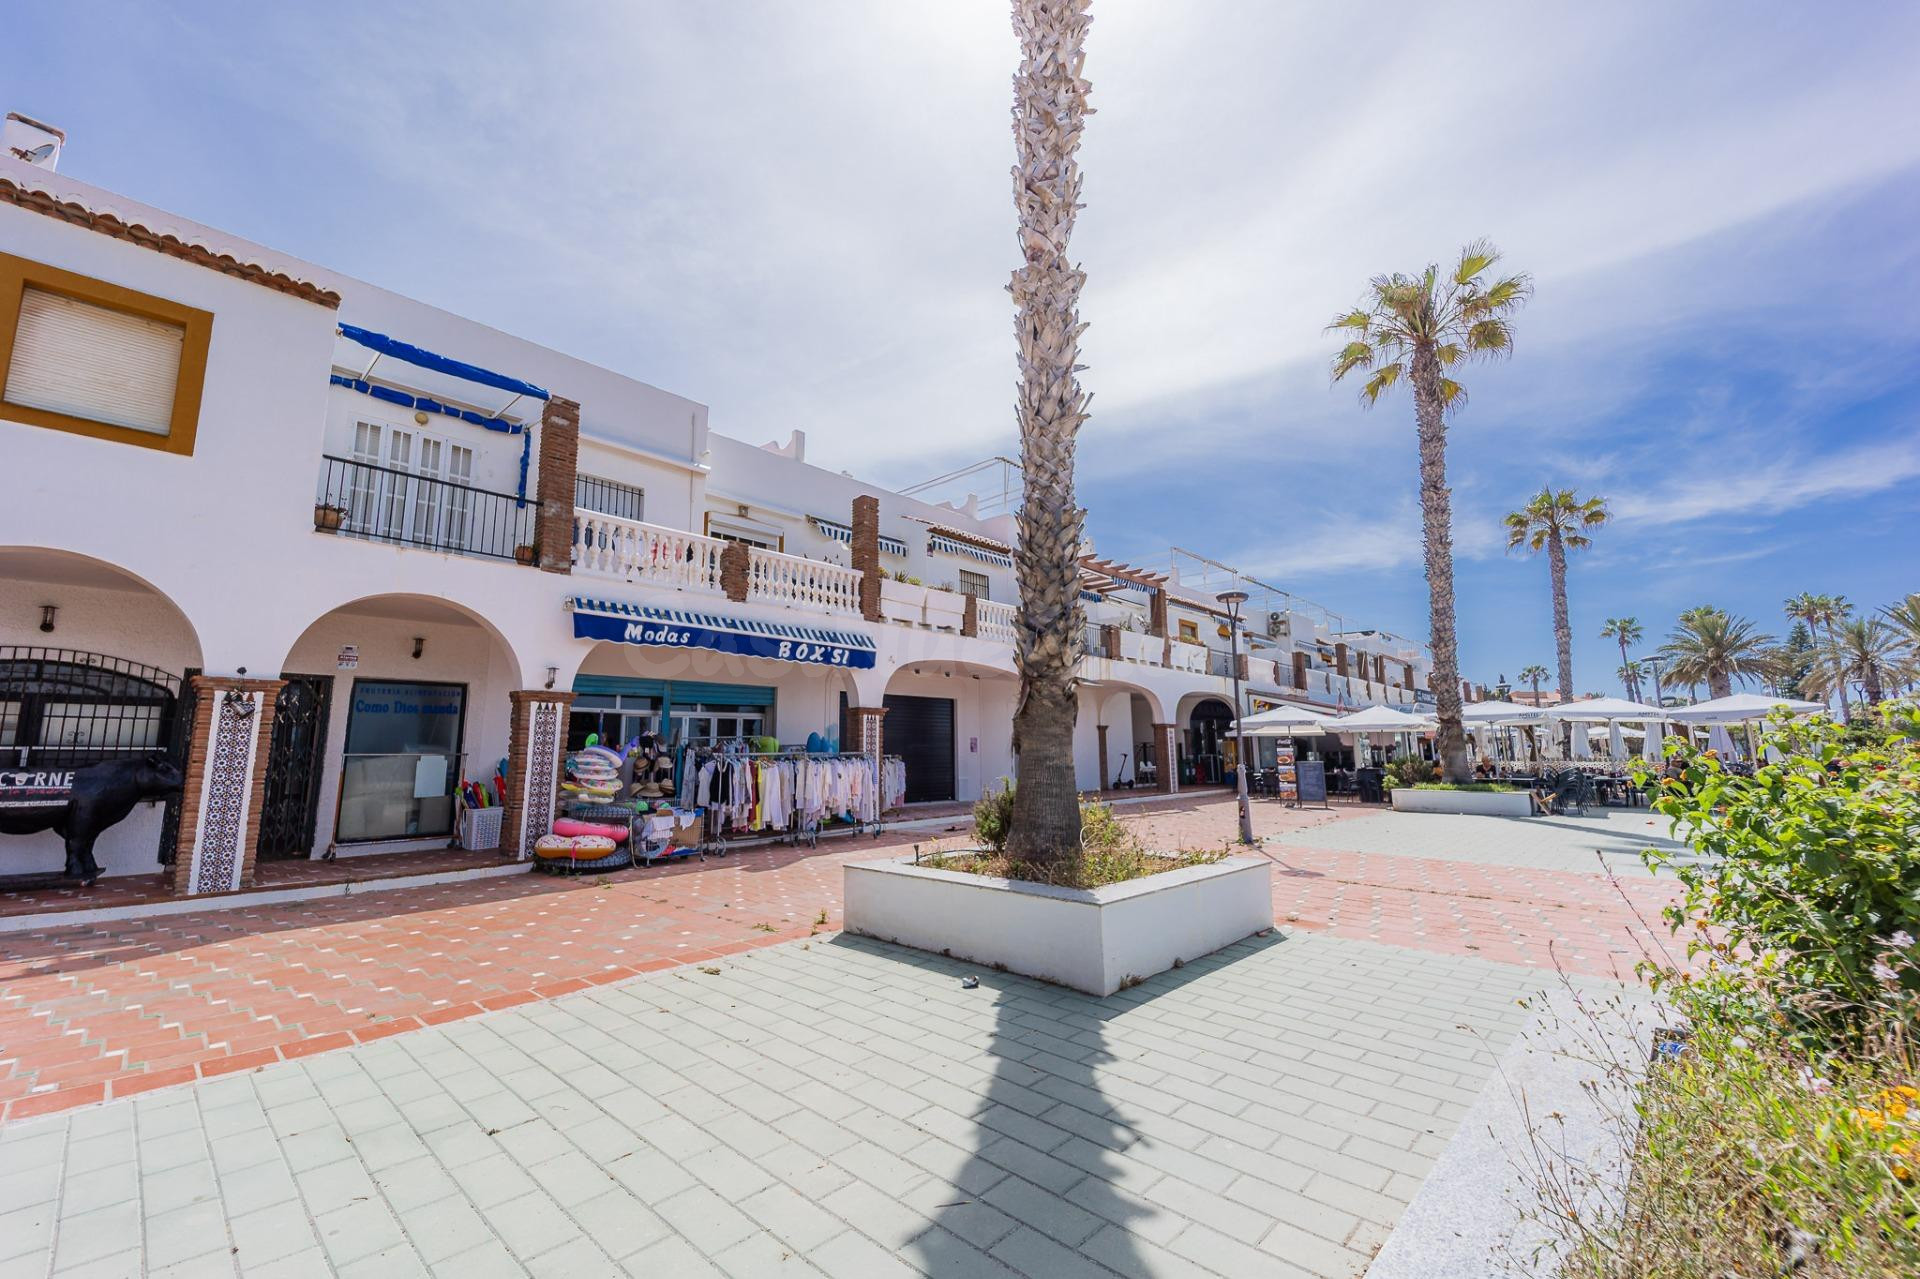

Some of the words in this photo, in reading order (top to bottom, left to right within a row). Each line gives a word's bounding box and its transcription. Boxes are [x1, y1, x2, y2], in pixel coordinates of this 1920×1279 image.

[624, 622, 691, 644] Modas
[356, 699, 389, 713] Como
[394, 701, 419, 714] Dios
[422, 702, 459, 715] manda
[0, 772, 75, 786] CRNE
